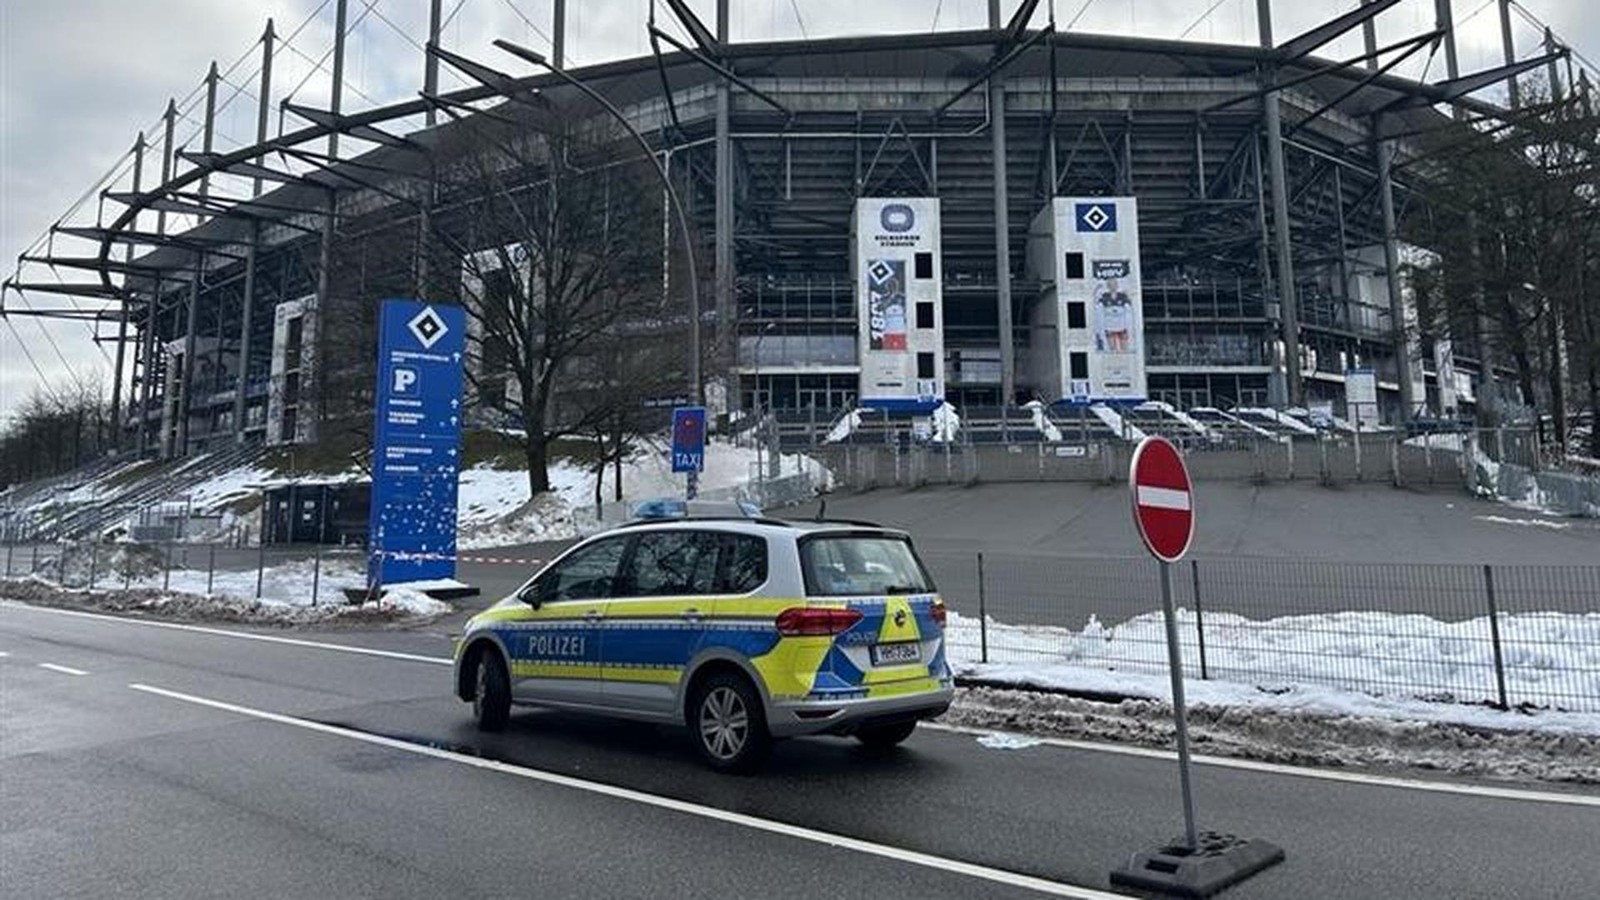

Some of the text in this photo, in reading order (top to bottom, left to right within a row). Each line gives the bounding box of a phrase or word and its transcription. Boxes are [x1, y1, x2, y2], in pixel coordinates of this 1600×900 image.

[394, 369, 416, 391] P
[675, 453, 701, 468] TAXI
[528, 635, 586, 656] POLIZEI
